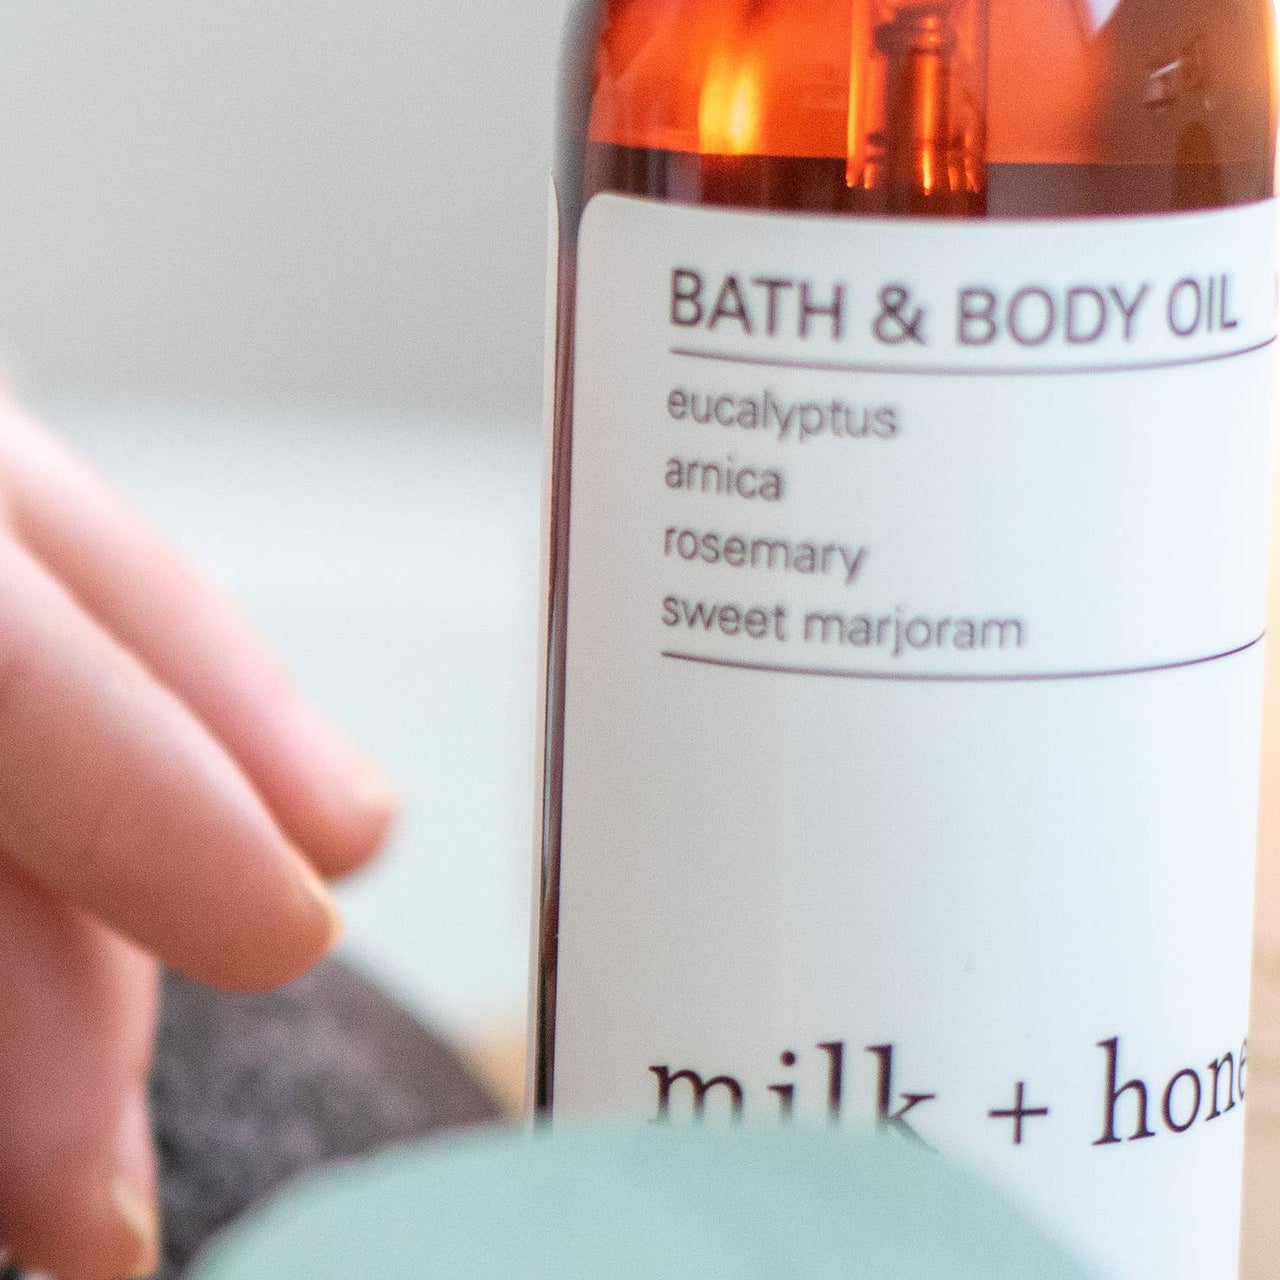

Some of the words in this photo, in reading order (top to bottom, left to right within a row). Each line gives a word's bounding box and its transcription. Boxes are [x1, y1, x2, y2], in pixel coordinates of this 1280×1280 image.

[671, 268, 848, 341] BATH
[871, 284, 927, 347] &
[957, 285, 1151, 349] BODY
[1167, 274, 1239, 338] OIL
[666, 387, 899, 442] eucalyptus
[664, 455, 783, 502] arnica
[664, 525, 868, 586] rosemary
[660, 595, 787, 643] sweet
[805, 605, 1026, 657] marjoram
[648, 1041, 937, 1152] milk
[988, 1080, 1049, 1146] +
